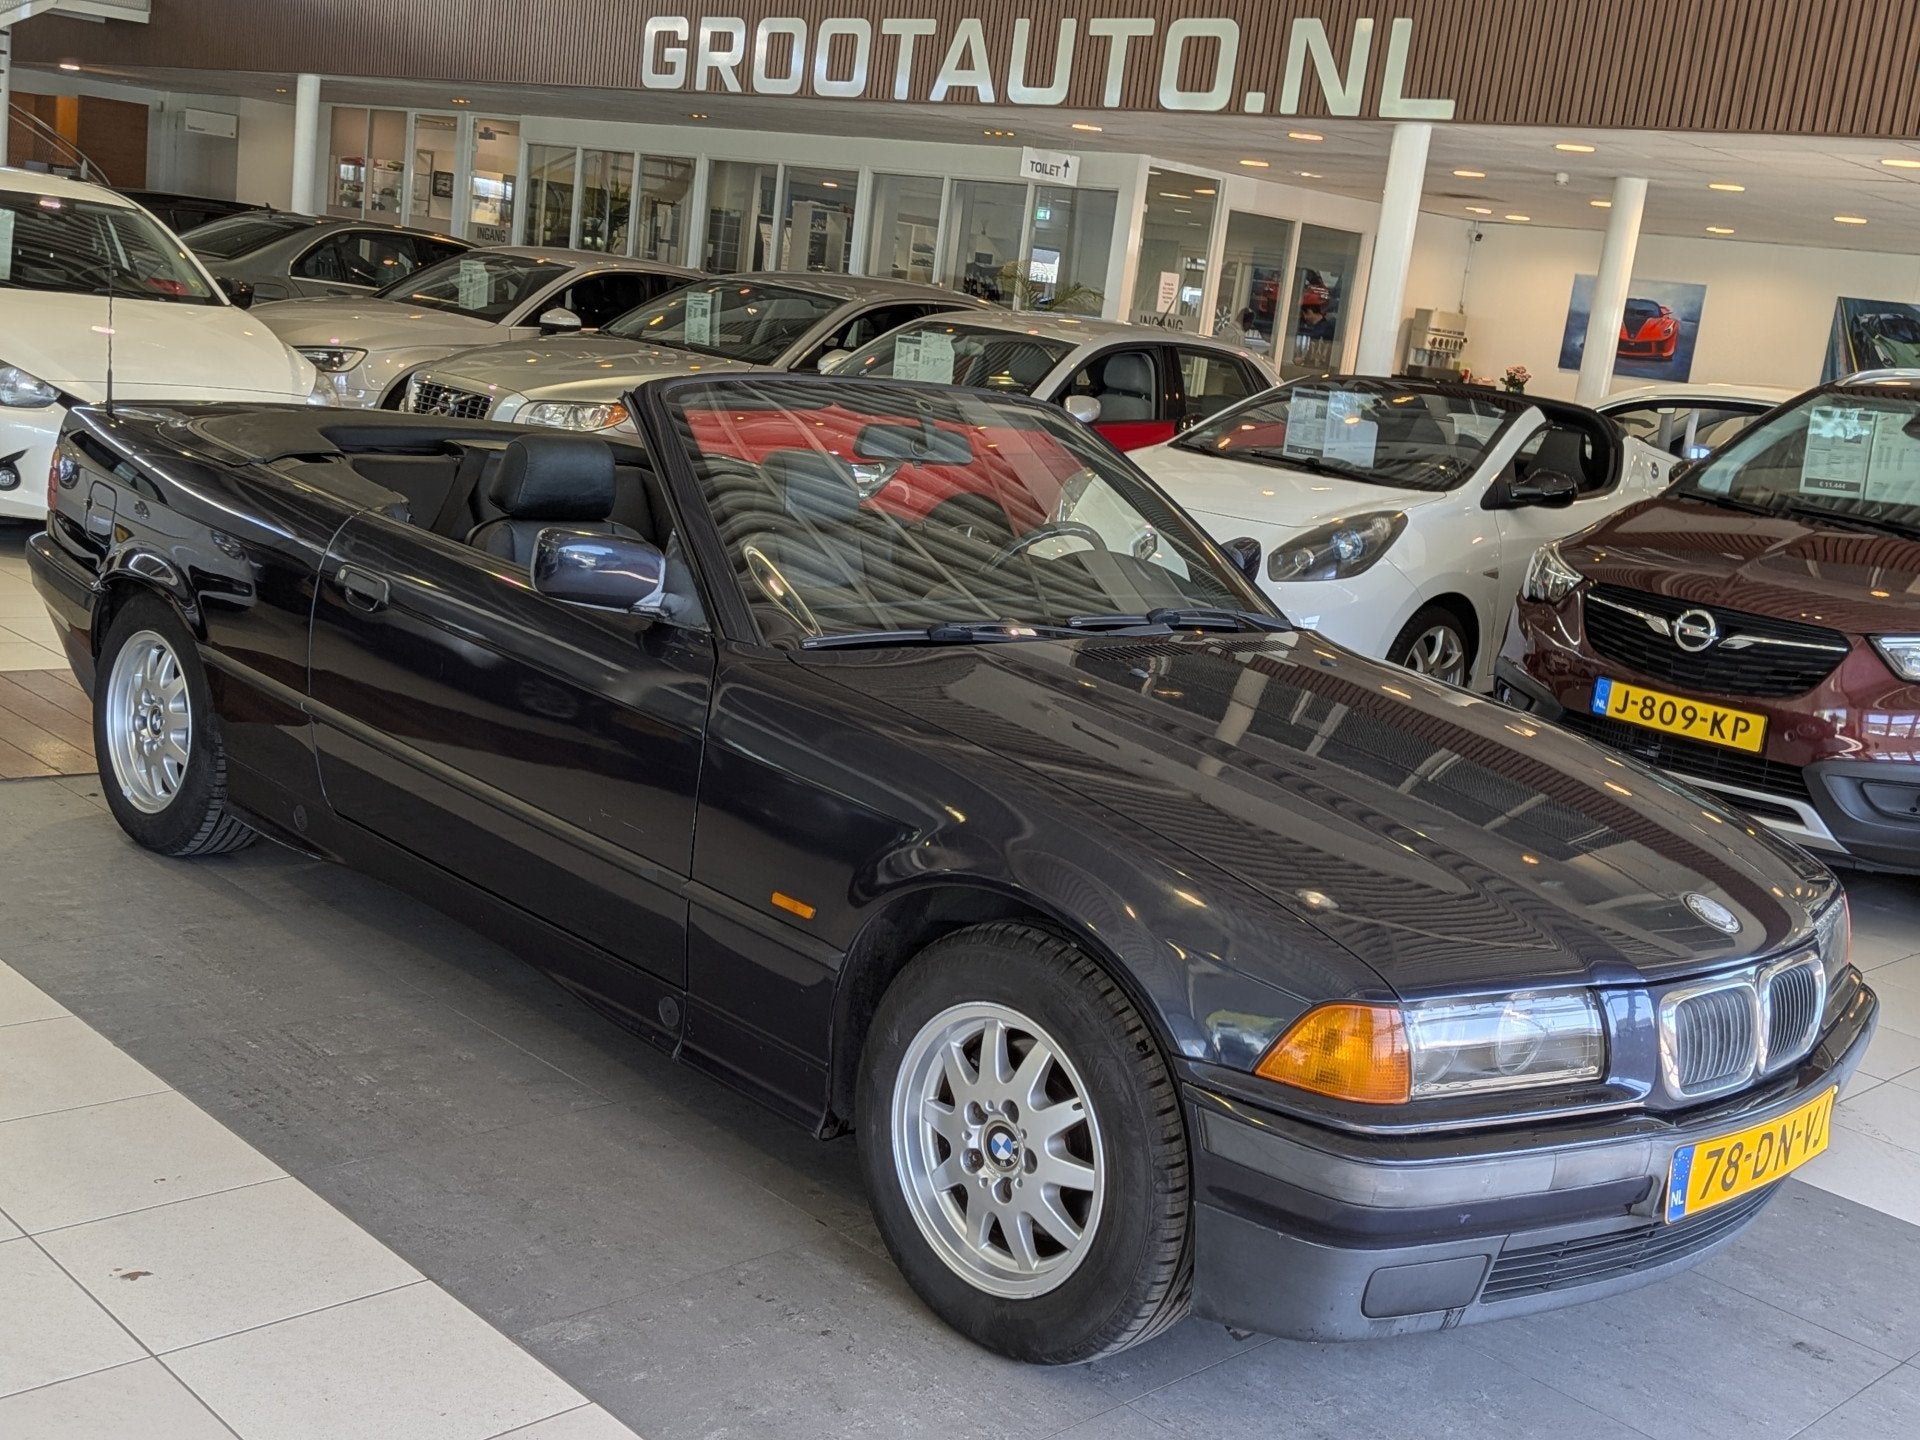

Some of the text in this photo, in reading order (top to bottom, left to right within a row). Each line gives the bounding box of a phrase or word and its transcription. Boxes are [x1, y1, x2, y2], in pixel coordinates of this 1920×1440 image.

[642, 16, 1456, 120] GROOTAUTO.NL
[1030, 160, 1061, 177] TOILET
[476, 226, 506, 243] INGANG
[1596, 690, 1750, 742] NL J-809-KP
[1670, 1100, 1829, 1208] NL 78-DN-VJ
